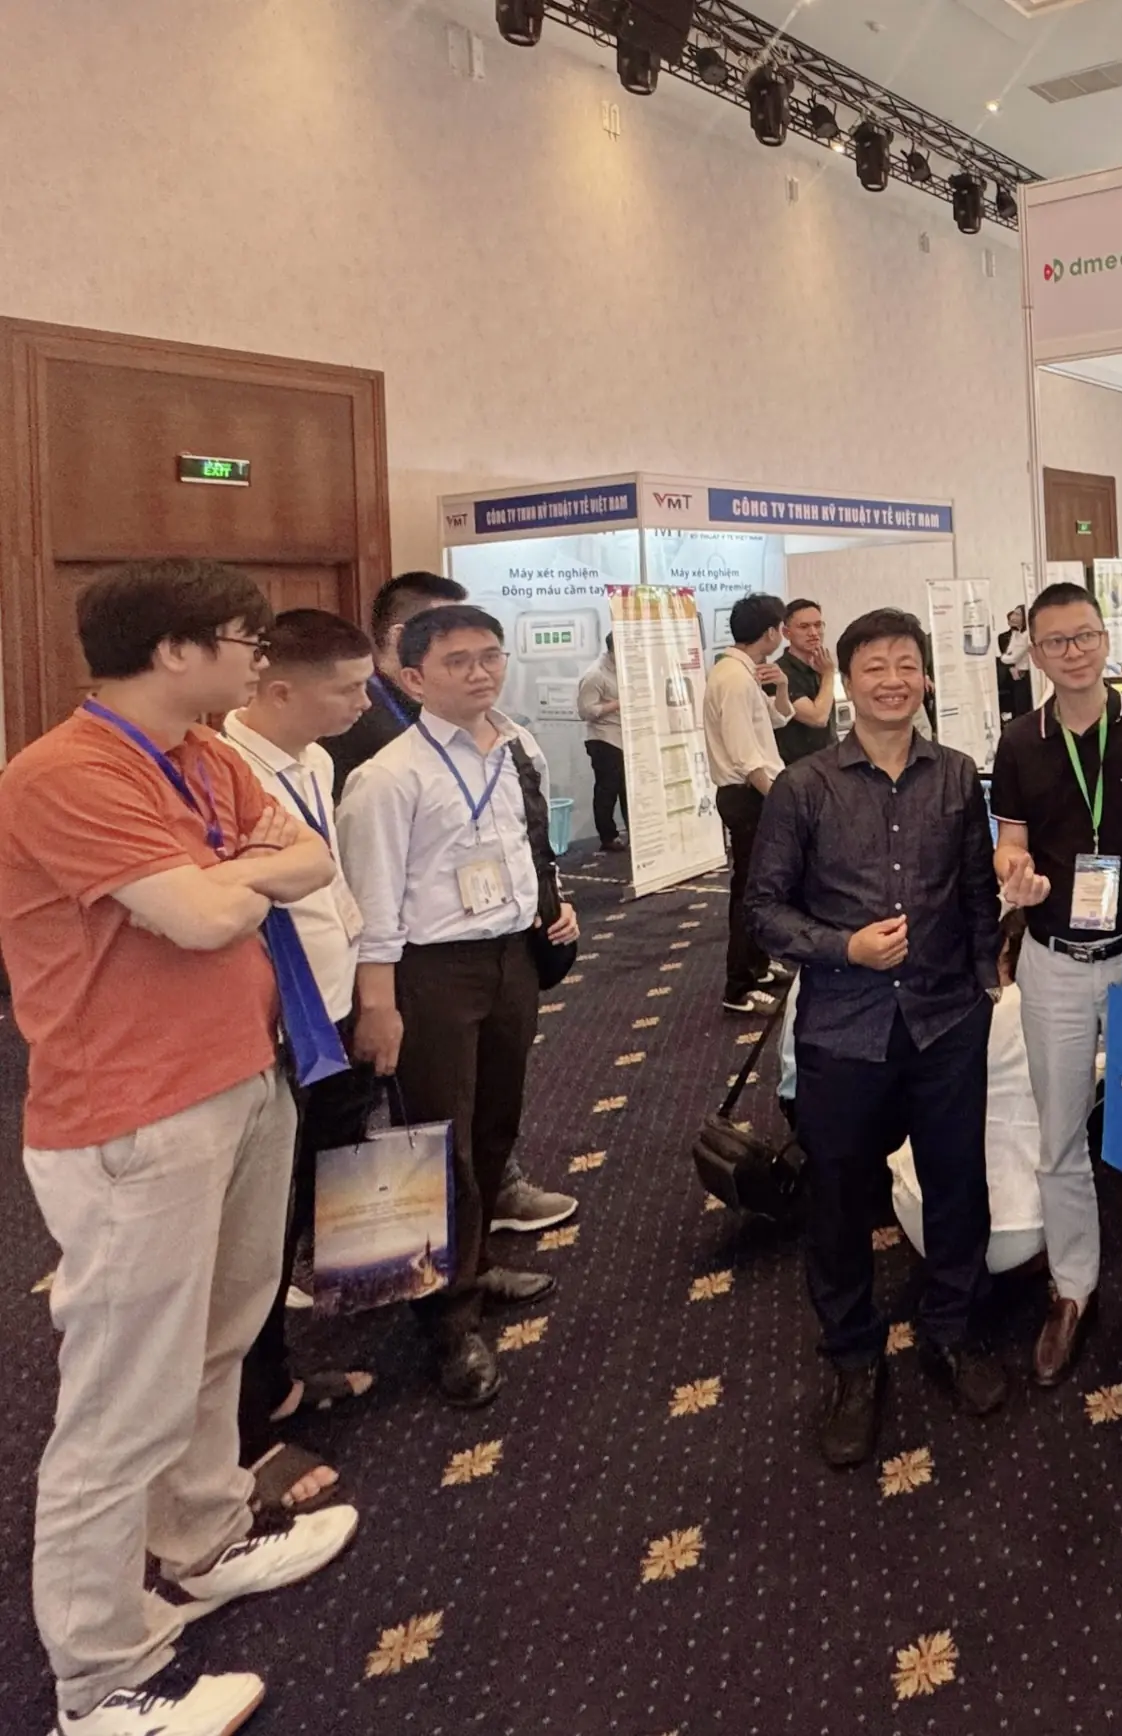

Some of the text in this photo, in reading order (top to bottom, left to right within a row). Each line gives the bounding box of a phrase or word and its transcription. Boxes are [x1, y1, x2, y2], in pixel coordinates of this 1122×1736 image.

[204, 467, 232, 478] EXIT
[653, 492, 693, 510] VMT
[486, 507, 506, 526] CÔNG
[507, 509, 517, 524] TY
[517, 506, 537, 522] TNHH
[548, 497, 573, 520] THUẬT
[573, 500, 580, 515] Y
[580, 495, 590, 515] TẾ
[590, 494, 608, 516] VIỆT
[608, 495, 629, 513] NAM
[732, 497, 940, 529] CÔNG TY TNHH KỸ THUẬT Y TẾ VIỆT NAM
[446, 513, 468, 528] VMT
[509, 566, 599, 582] Máy xét nghiệm
[671, 567, 740, 579] Máy xét nghiệm
[536, 585, 561, 596] máu
[589, 586, 606, 598] tay
[699, 583, 718, 592] GEM
[720, 582, 752, 592] Premier
